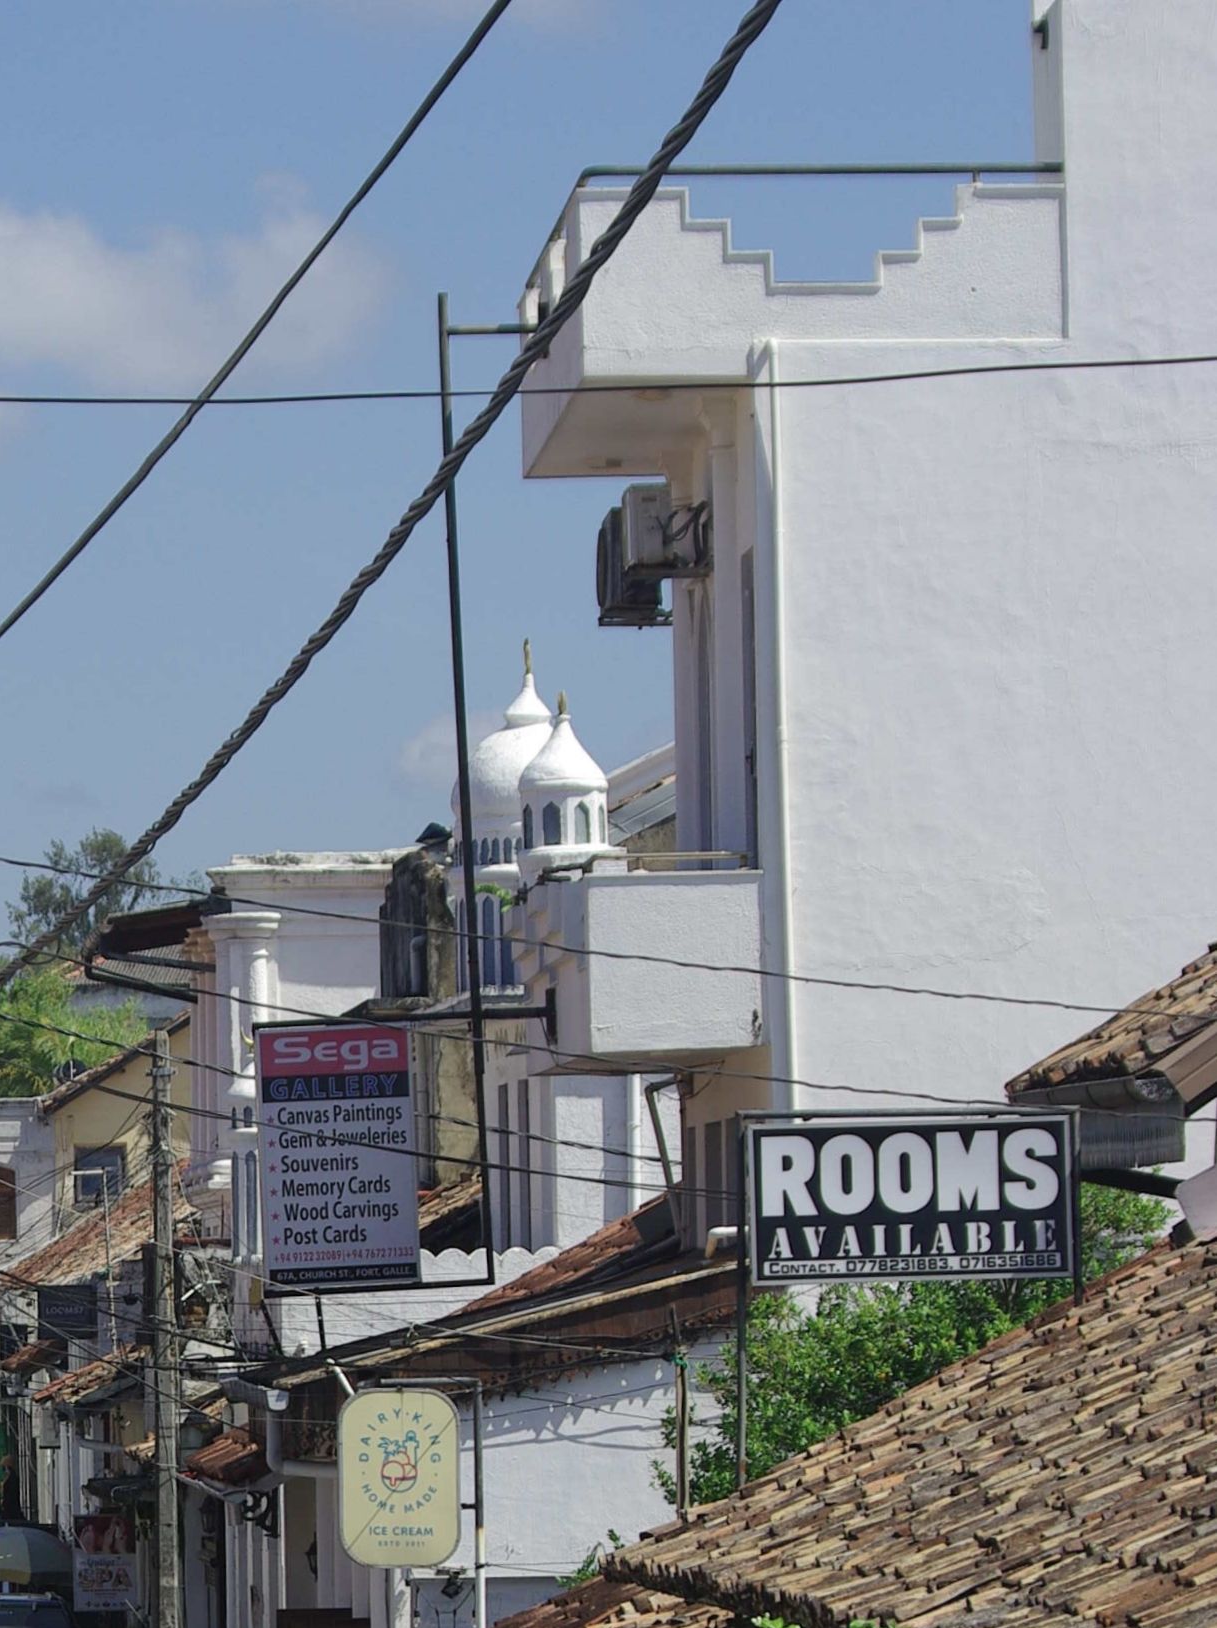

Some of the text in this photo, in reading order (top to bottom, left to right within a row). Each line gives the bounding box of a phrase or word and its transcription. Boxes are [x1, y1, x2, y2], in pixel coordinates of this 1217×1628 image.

[273, 1036, 398, 1070] Sega
[270, 1074, 398, 1099] GALLERY
[277, 1103, 402, 1125] Canvas Paintings
[279, 1131, 312, 1149] Gem
[317, 1129, 327, 1147] &
[281, 1153, 359, 1173] Souvenirs
[760, 1128, 1059, 1217] ROOMS
[282, 1175, 391, 1199] Memory Cards
[285, 1200, 399, 1222] Wood Carvings
[284, 1224, 367, 1245] Post Cards
[768, 1219, 1057, 1259] AVAILABLE
[299, 1271, 336, 1280] CHURCH
[359, 1408, 403, 1462] DAIRY
[411, 1411, 442, 1464] KING
[361, 1484, 438, 1513] HOME MADE
[369, 1526, 433, 1536] ICE CREAM
